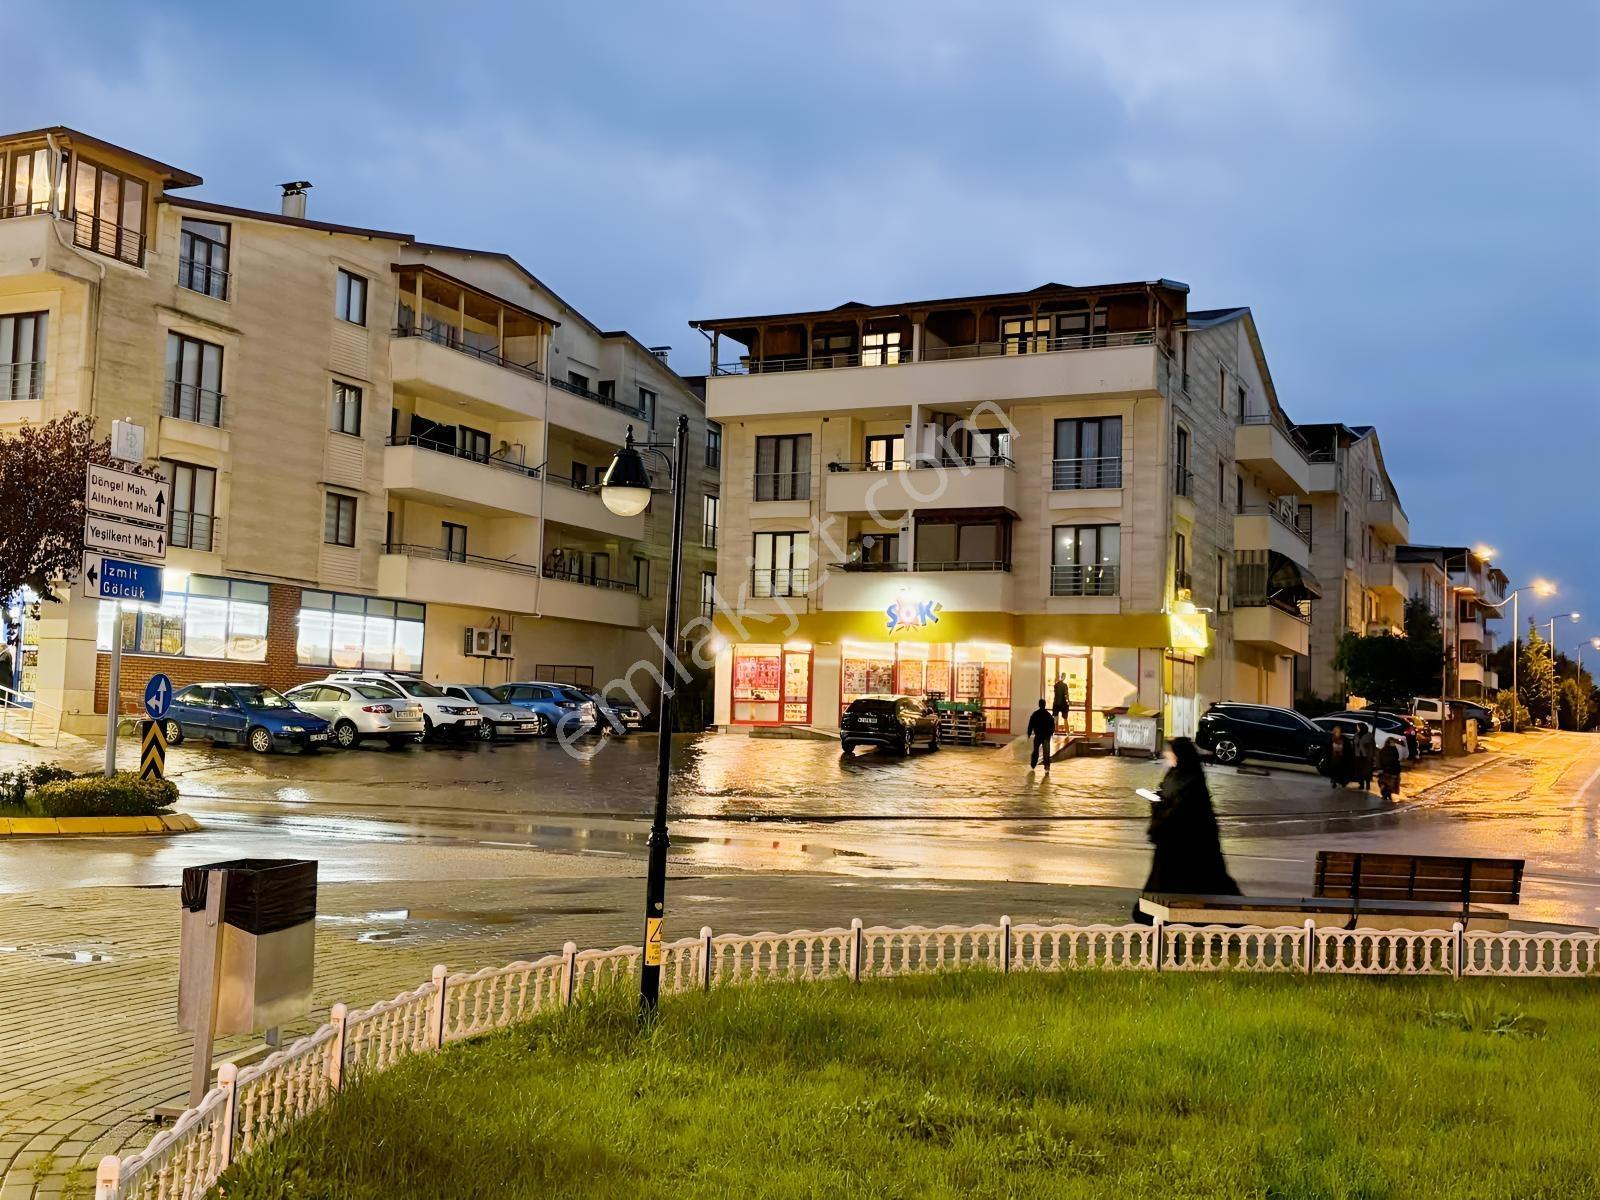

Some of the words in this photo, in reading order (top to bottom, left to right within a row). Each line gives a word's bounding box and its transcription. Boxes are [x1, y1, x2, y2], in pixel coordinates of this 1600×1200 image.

[92, 474, 124, 491] Döngel
[127, 482, 147, 496] Mah.
[91, 492, 133, 511] Altınkent
[136, 501, 155, 515] Mah.
[90, 526, 131, 545] Yeşilkent
[134, 535, 155, 549] Mah.
[104, 560, 138, 579] İzmit
[103, 581, 145, 599] Gölcük
